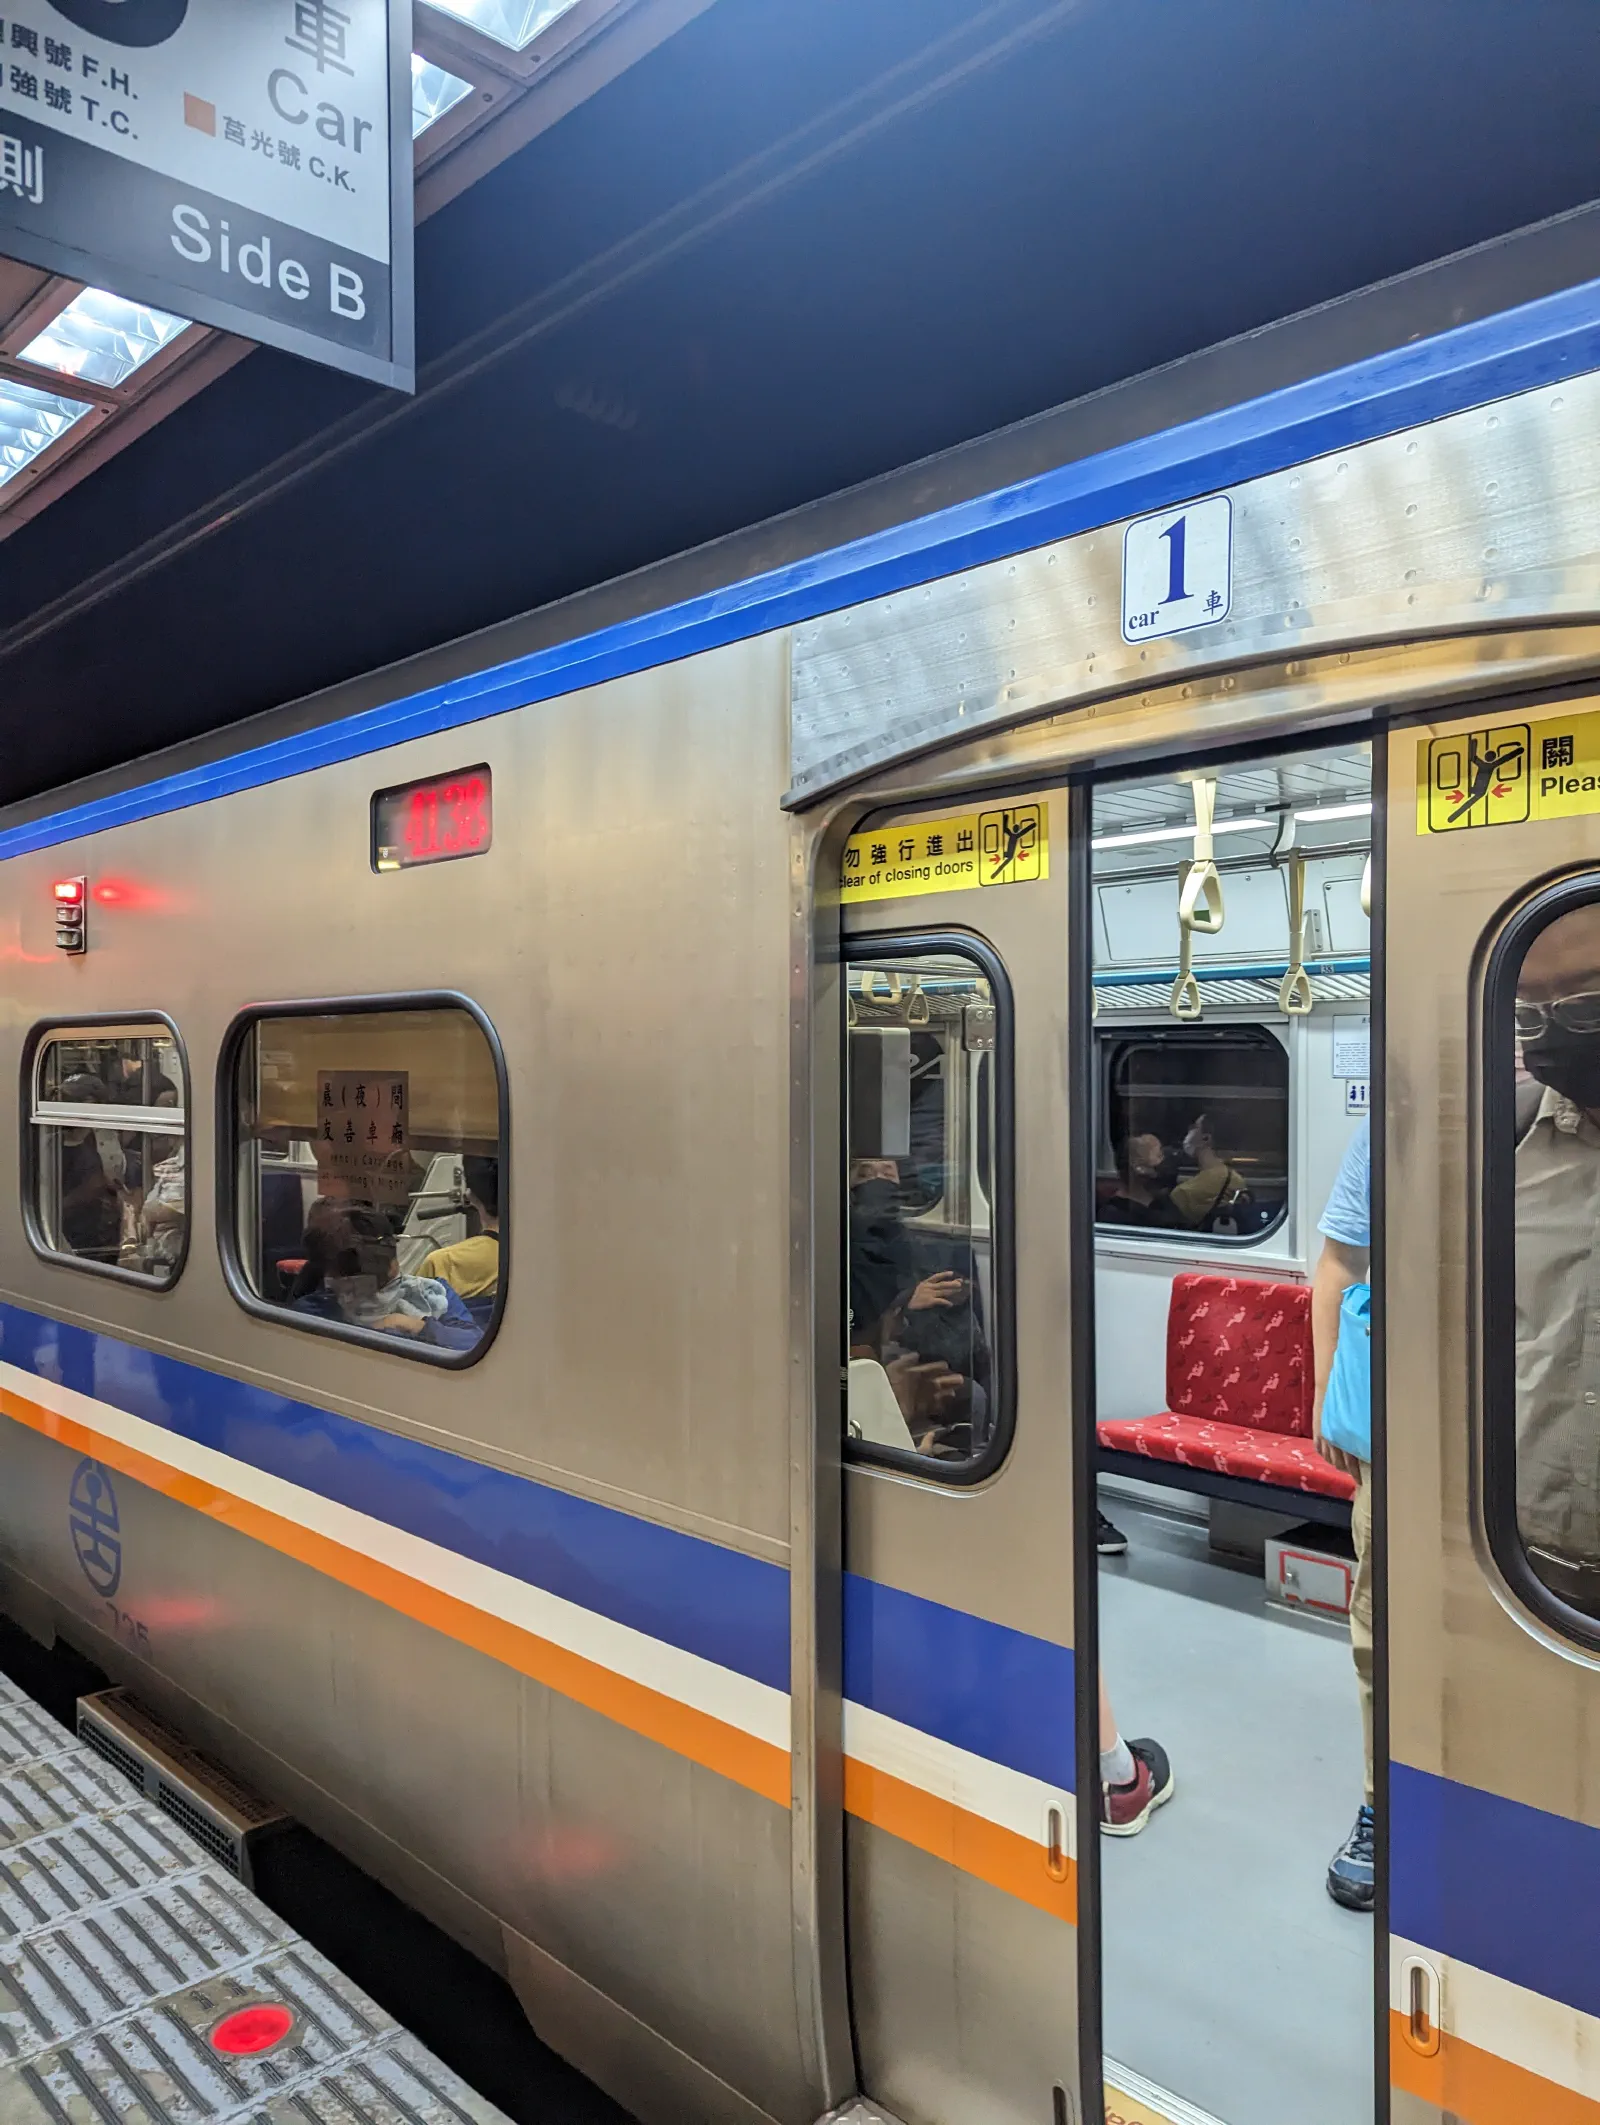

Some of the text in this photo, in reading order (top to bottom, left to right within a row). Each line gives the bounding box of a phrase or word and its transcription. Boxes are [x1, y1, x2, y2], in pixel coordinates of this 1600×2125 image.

[0, 19, 139, 100] 興號 F.H.
[284, 0, 354, 77] 車
[0, 63, 139, 140] 強號 T.C.
[267, 68, 373, 154] Car
[222, 115, 356, 193] 莒光號 C.K.
[170, 204, 366, 321] Side B
[1158, 515, 1195, 605] 1
[1128, 610, 1160, 630] car
[1202, 590, 1223, 616] 車
[1541, 775, 1600, 797] Plea
[1542, 735, 1574, 769] 關
[844, 829, 974, 868] 勿強行進出
[869, 871, 881, 885] of
[885, 867, 931, 883] closing
[934, 860, 974, 877] doors
